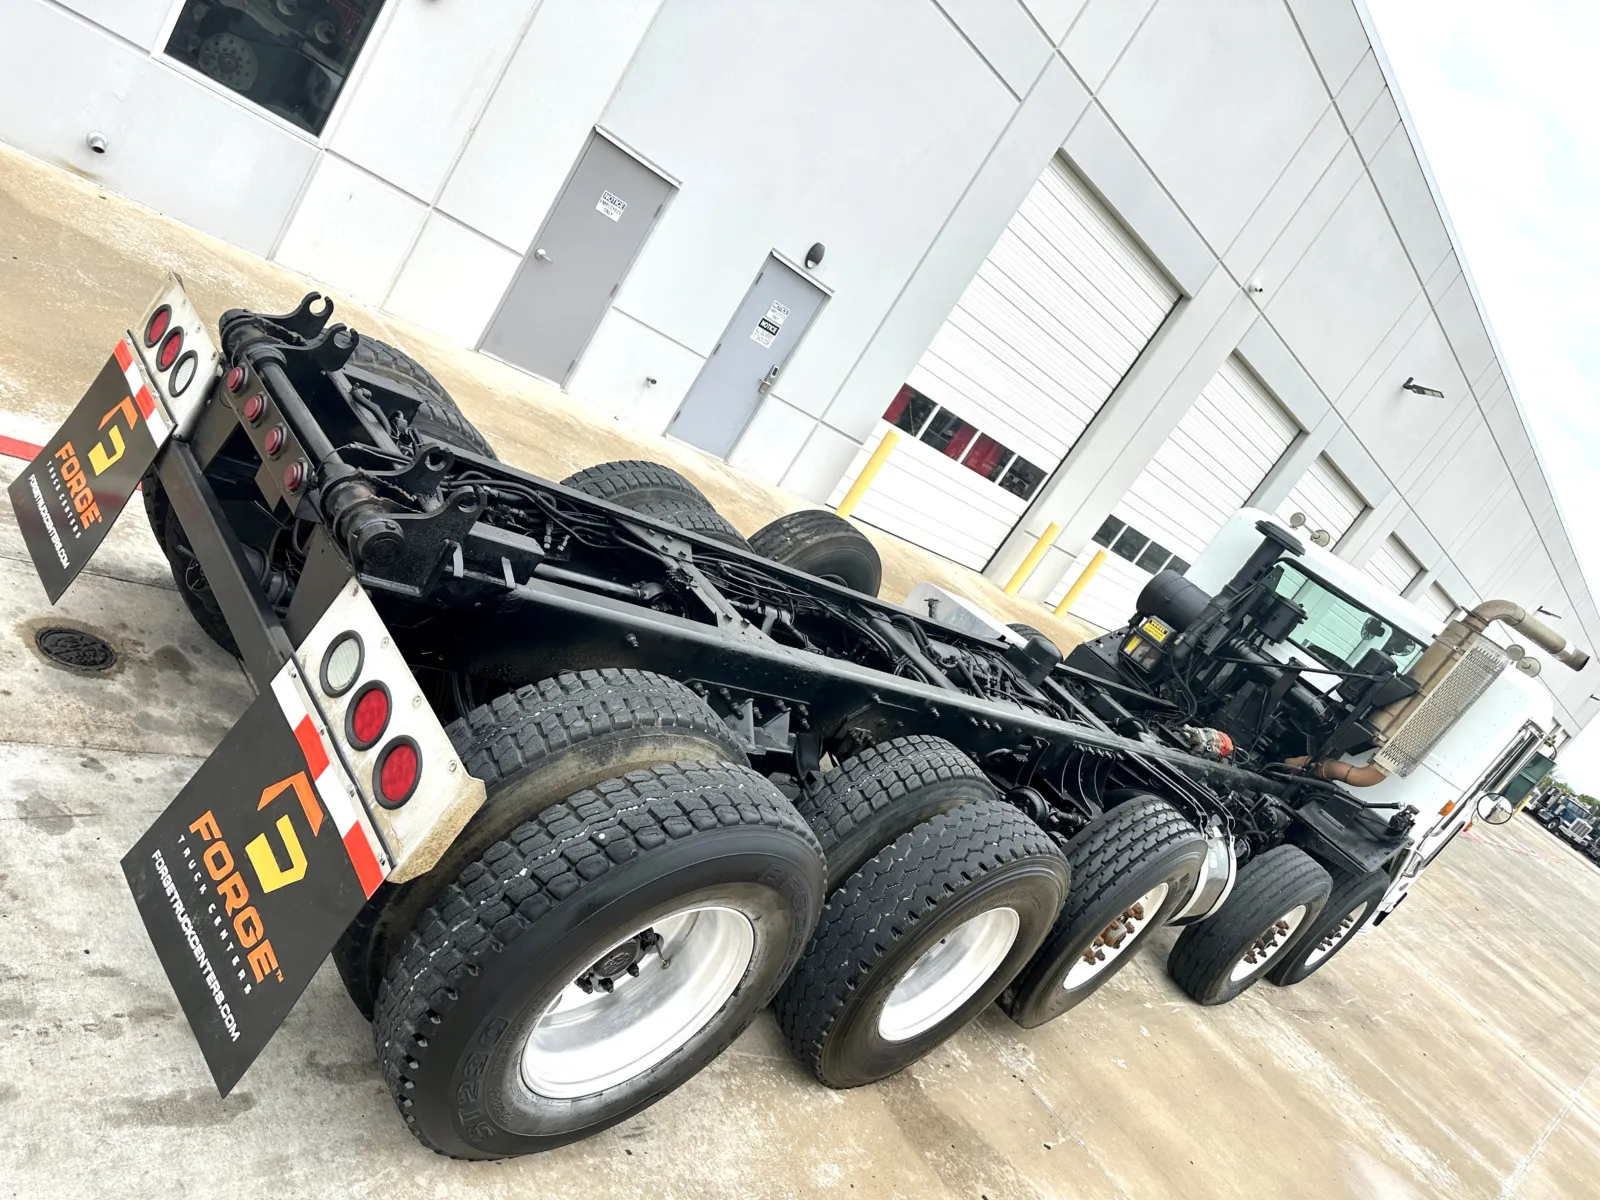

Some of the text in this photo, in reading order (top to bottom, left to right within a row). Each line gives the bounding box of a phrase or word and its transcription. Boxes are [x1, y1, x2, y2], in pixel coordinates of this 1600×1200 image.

[603, 192, 626, 210] NOTICE
[760, 320, 778, 334] NOTICE
[28, 473, 71, 570] FORGETRUCKCENTERS.COM
[47, 461, 82, 539] TRUCK CENTERS
[151, 848, 241, 1042] FORGETRUCKCENTERS.COM
[177, 834, 252, 995] TRUCK CENTERS
